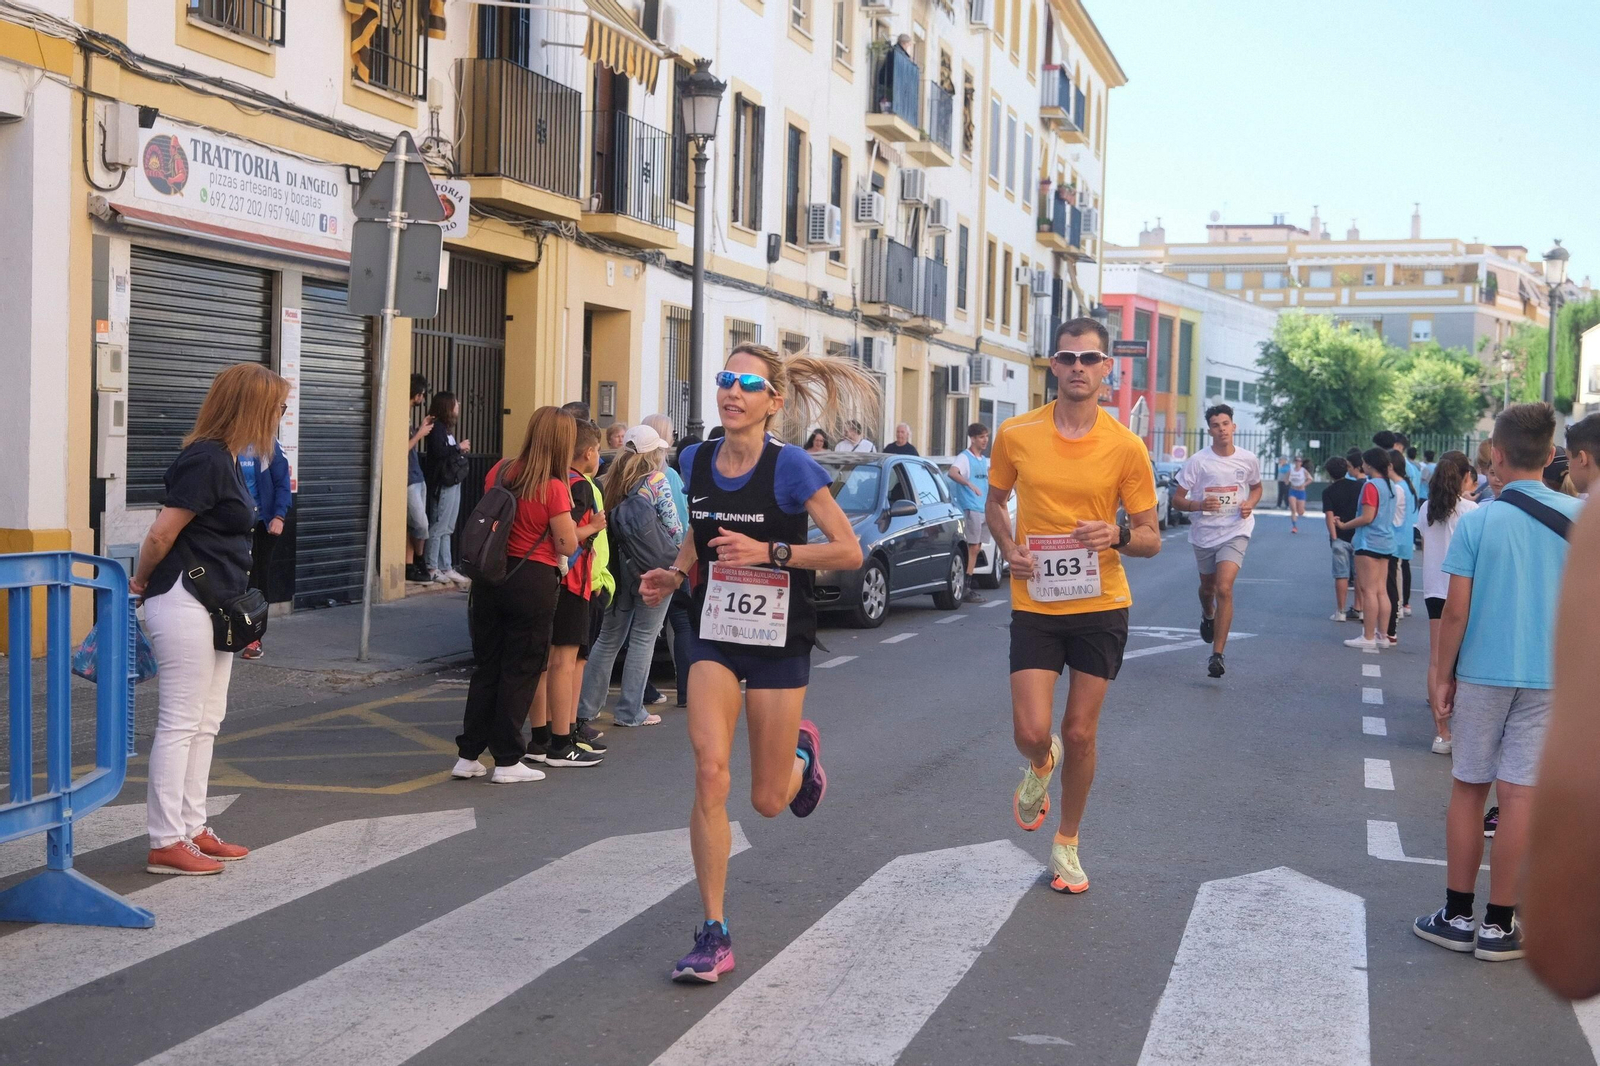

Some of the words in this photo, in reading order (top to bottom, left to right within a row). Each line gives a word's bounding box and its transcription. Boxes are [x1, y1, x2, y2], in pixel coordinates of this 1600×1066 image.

[190, 138, 280, 183] TRATTORIA
[286, 171, 297, 186] DI
[300, 178, 338, 198] ANGELO
[209, 168, 238, 190] pizzas
[240, 178, 283, 200] artesanas
[284, 191, 290, 205] y
[291, 188, 322, 210] bocatas
[434, 184, 464, 203] TORIA
[210, 190, 226, 210] 692
[229, 194, 244, 212] 237
[285, 208, 300, 225] 940
[302, 212, 316, 228] 607
[1219, 496, 1230, 504] 52
[692, 510, 764, 522] TOP4RUNNING
[1044, 558, 1081, 576] 163
[724, 592, 766, 616] 162
